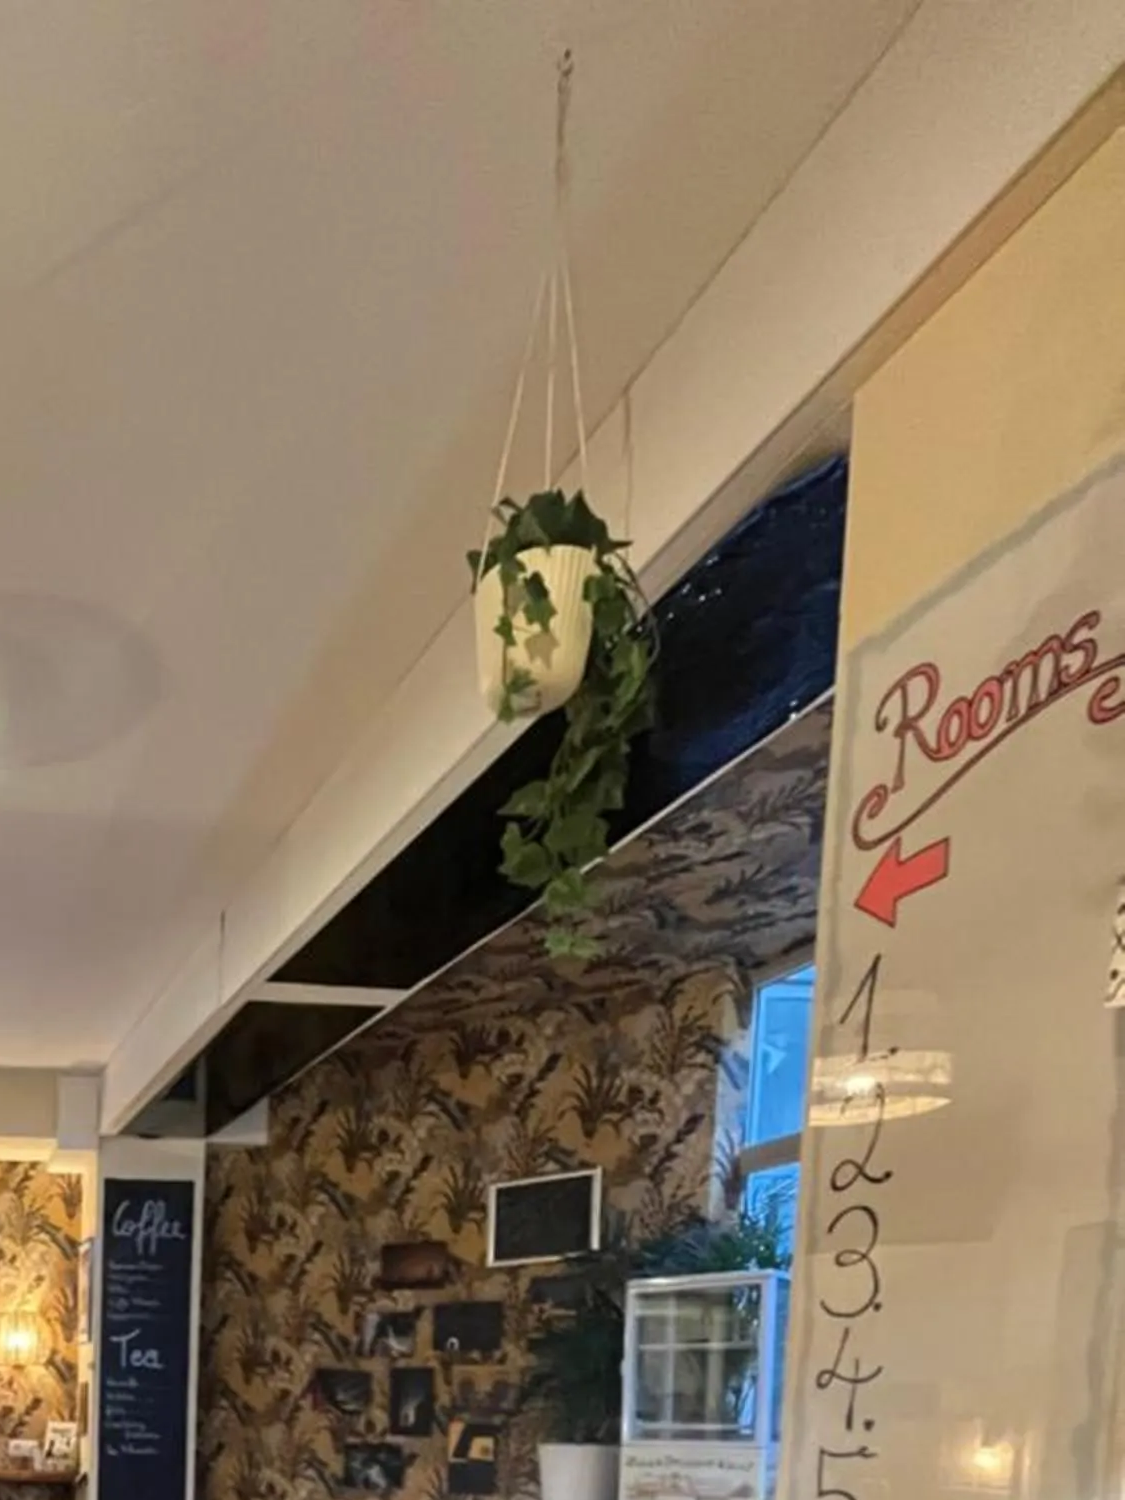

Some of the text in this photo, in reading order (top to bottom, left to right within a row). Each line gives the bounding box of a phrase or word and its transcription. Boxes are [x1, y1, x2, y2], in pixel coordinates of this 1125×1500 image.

[875, 610, 1101, 792] Rooms
[840, 954, 899, 1063] 1.
[112, 1199, 186, 1256] Coffee
[820, 1204, 881, 1318] 3.
[109, 1328, 165, 1369] Tea
[816, 1327, 882, 1431] 4.
